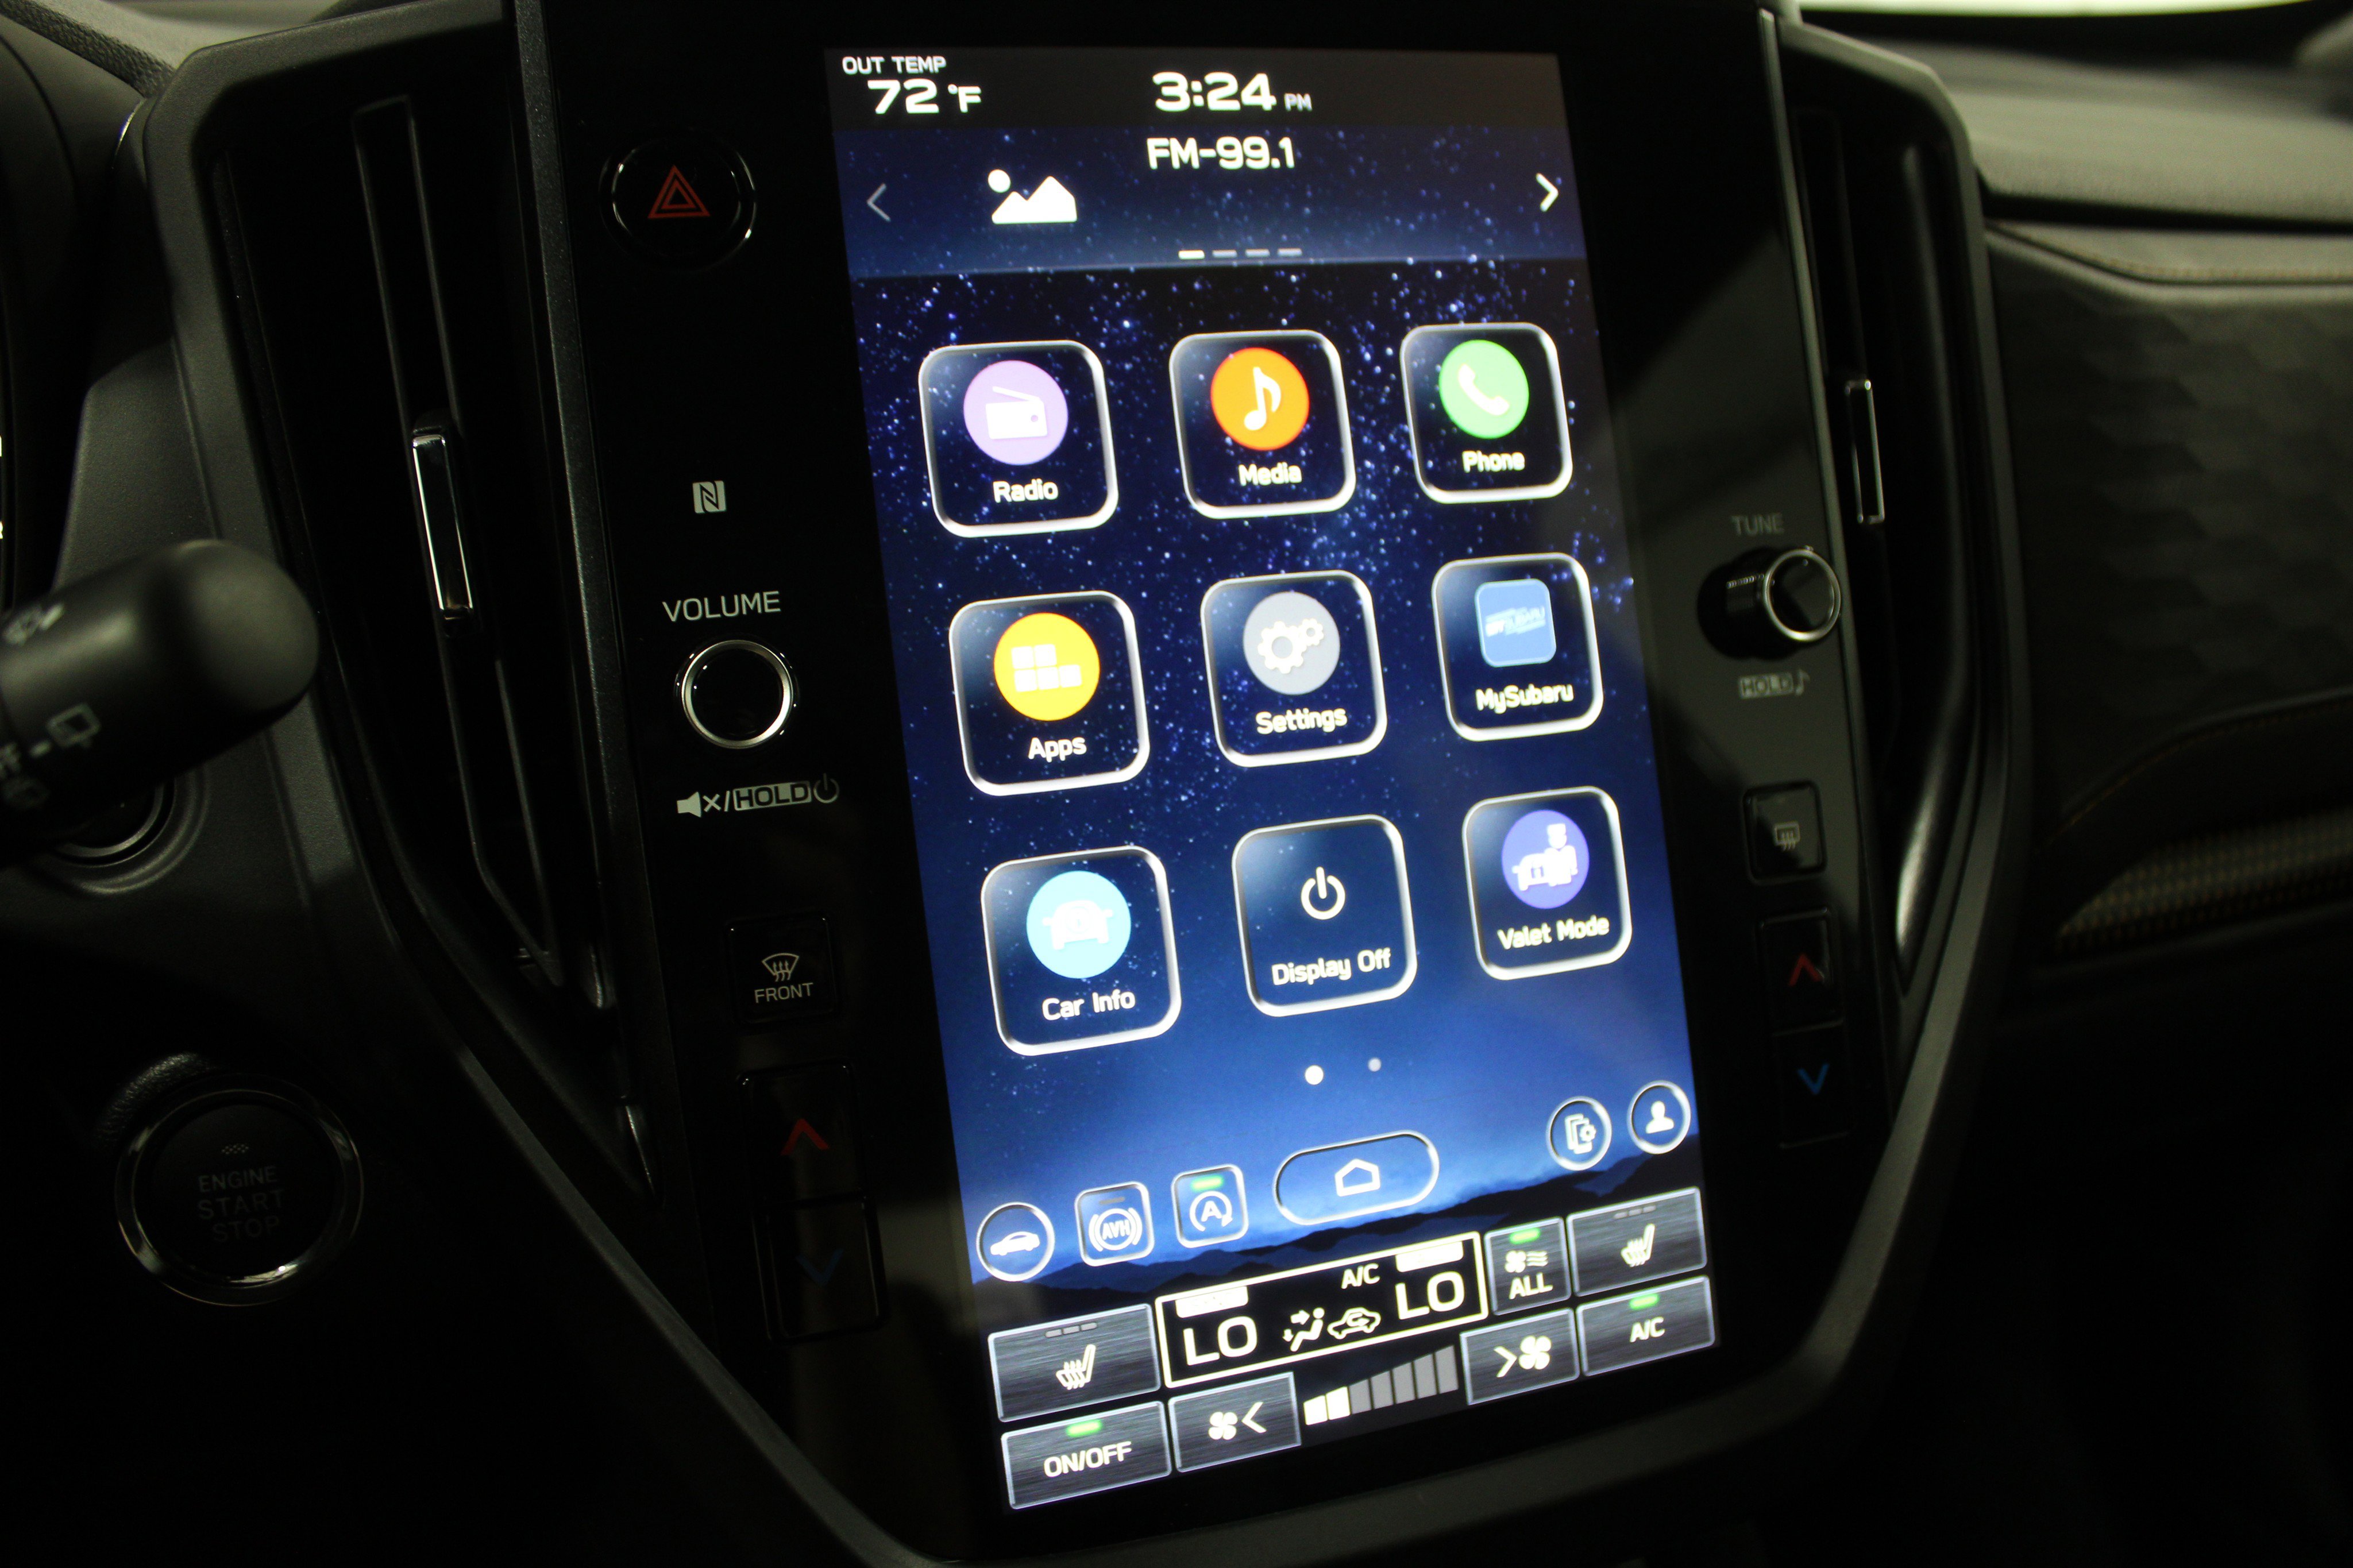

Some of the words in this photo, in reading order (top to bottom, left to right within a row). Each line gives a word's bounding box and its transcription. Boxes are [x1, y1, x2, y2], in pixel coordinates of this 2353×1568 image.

[842, 56, 885, 75] OUT
[891, 56, 947, 74] TEMP
[867, 78, 939, 114] 72
[1152, 71, 1277, 111] 3:24
[1284, 92, 1312, 111] PM
[1147, 136, 1295, 169] FM-99.1
[1239, 462, 1302, 487] Media
[1461, 450, 1526, 473] Phone
[993, 478, 1059, 503] Radio
[1730, 513, 1784, 536] TUNE
[662, 590, 782, 622] VOLUME
[1475, 683, 1574, 715] MySubaru
[1255, 708, 1348, 735] Settings
[1028, 736, 1087, 762] Apps
[1497, 922, 1552, 949] Valet
[1556, 914, 1610, 941] Mode
[1271, 957, 1352, 986] Display
[1357, 947, 1392, 973] Off
[754, 982, 814, 1003] FRONT
[1041, 995, 1085, 1022] Car
[1091, 988, 1137, 1014] Info
[198, 1166, 277, 1194] ENGINE
[196, 1189, 284, 1220] START
[212, 1216, 281, 1243] STOP
[1102, 1220, 1132, 1239] AVH
[1341, 1264, 1380, 1289] A/C
[1508, 1276, 1553, 1300] ALL
[1395, 1270, 1465, 1321] LO
[1629, 1316, 1665, 1343] A/C
[1183, 1322, 1258, 1366] LO
[1043, 1441, 1133, 1478] ON/OFF
